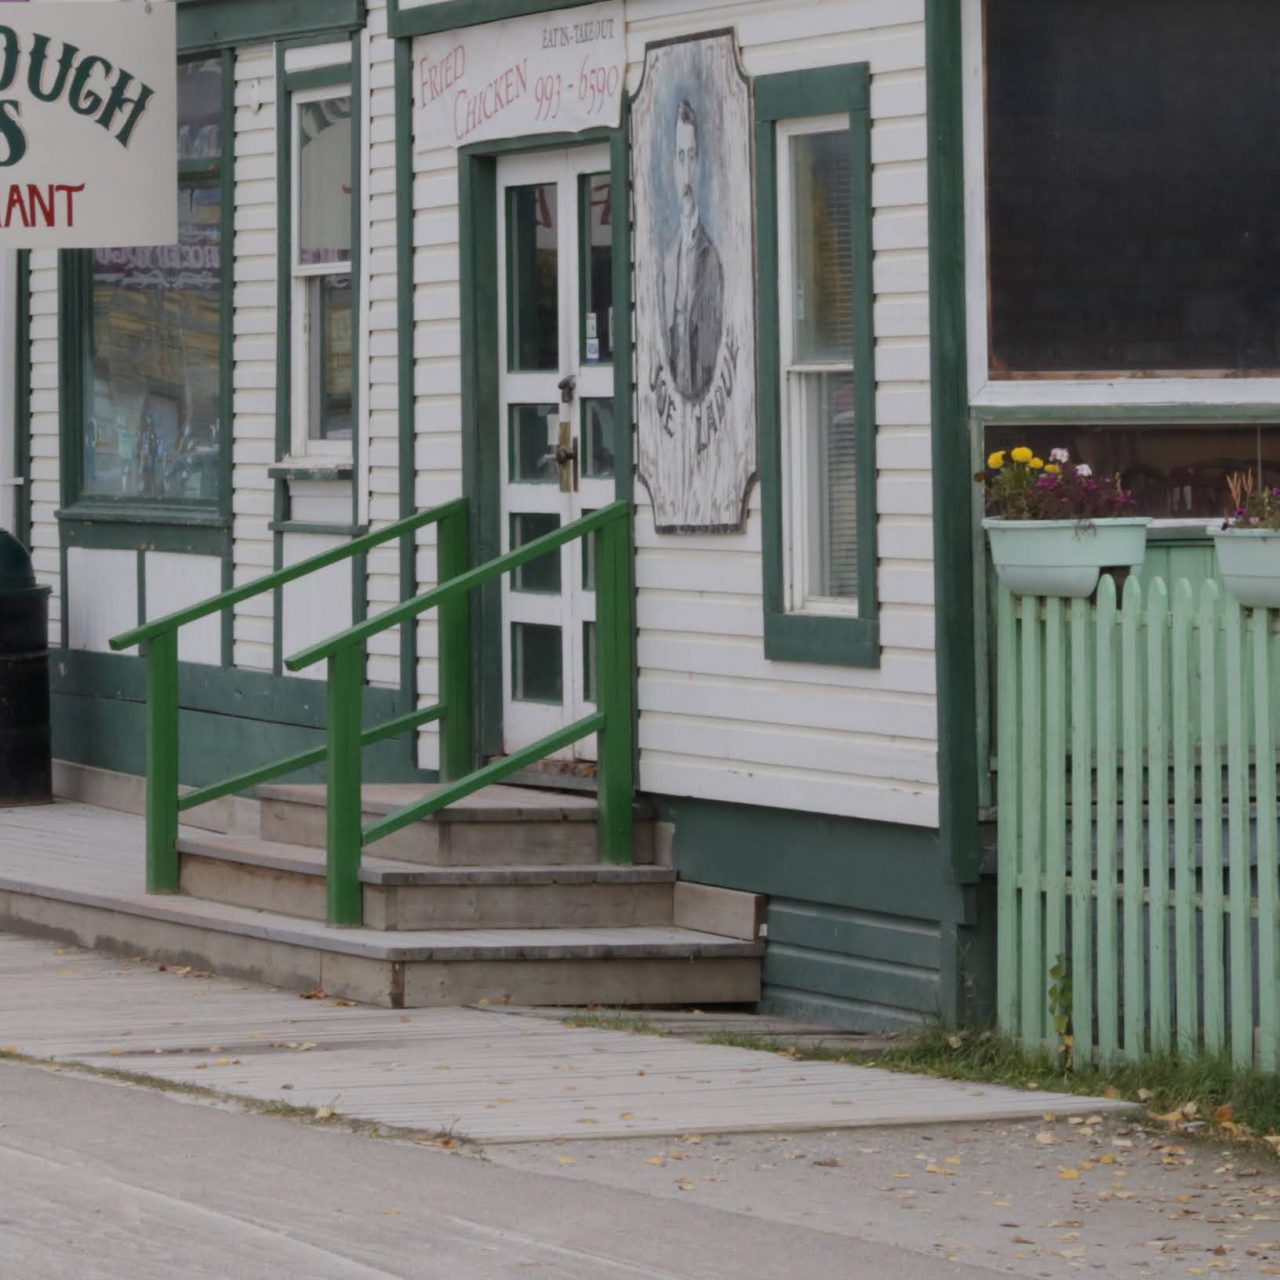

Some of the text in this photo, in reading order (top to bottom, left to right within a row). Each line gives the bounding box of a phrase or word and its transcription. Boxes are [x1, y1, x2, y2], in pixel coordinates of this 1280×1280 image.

[420, 44, 465, 109] FRIED
[454, 58, 528, 140] CHICKEN
[648, 362, 677, 440] JOE
